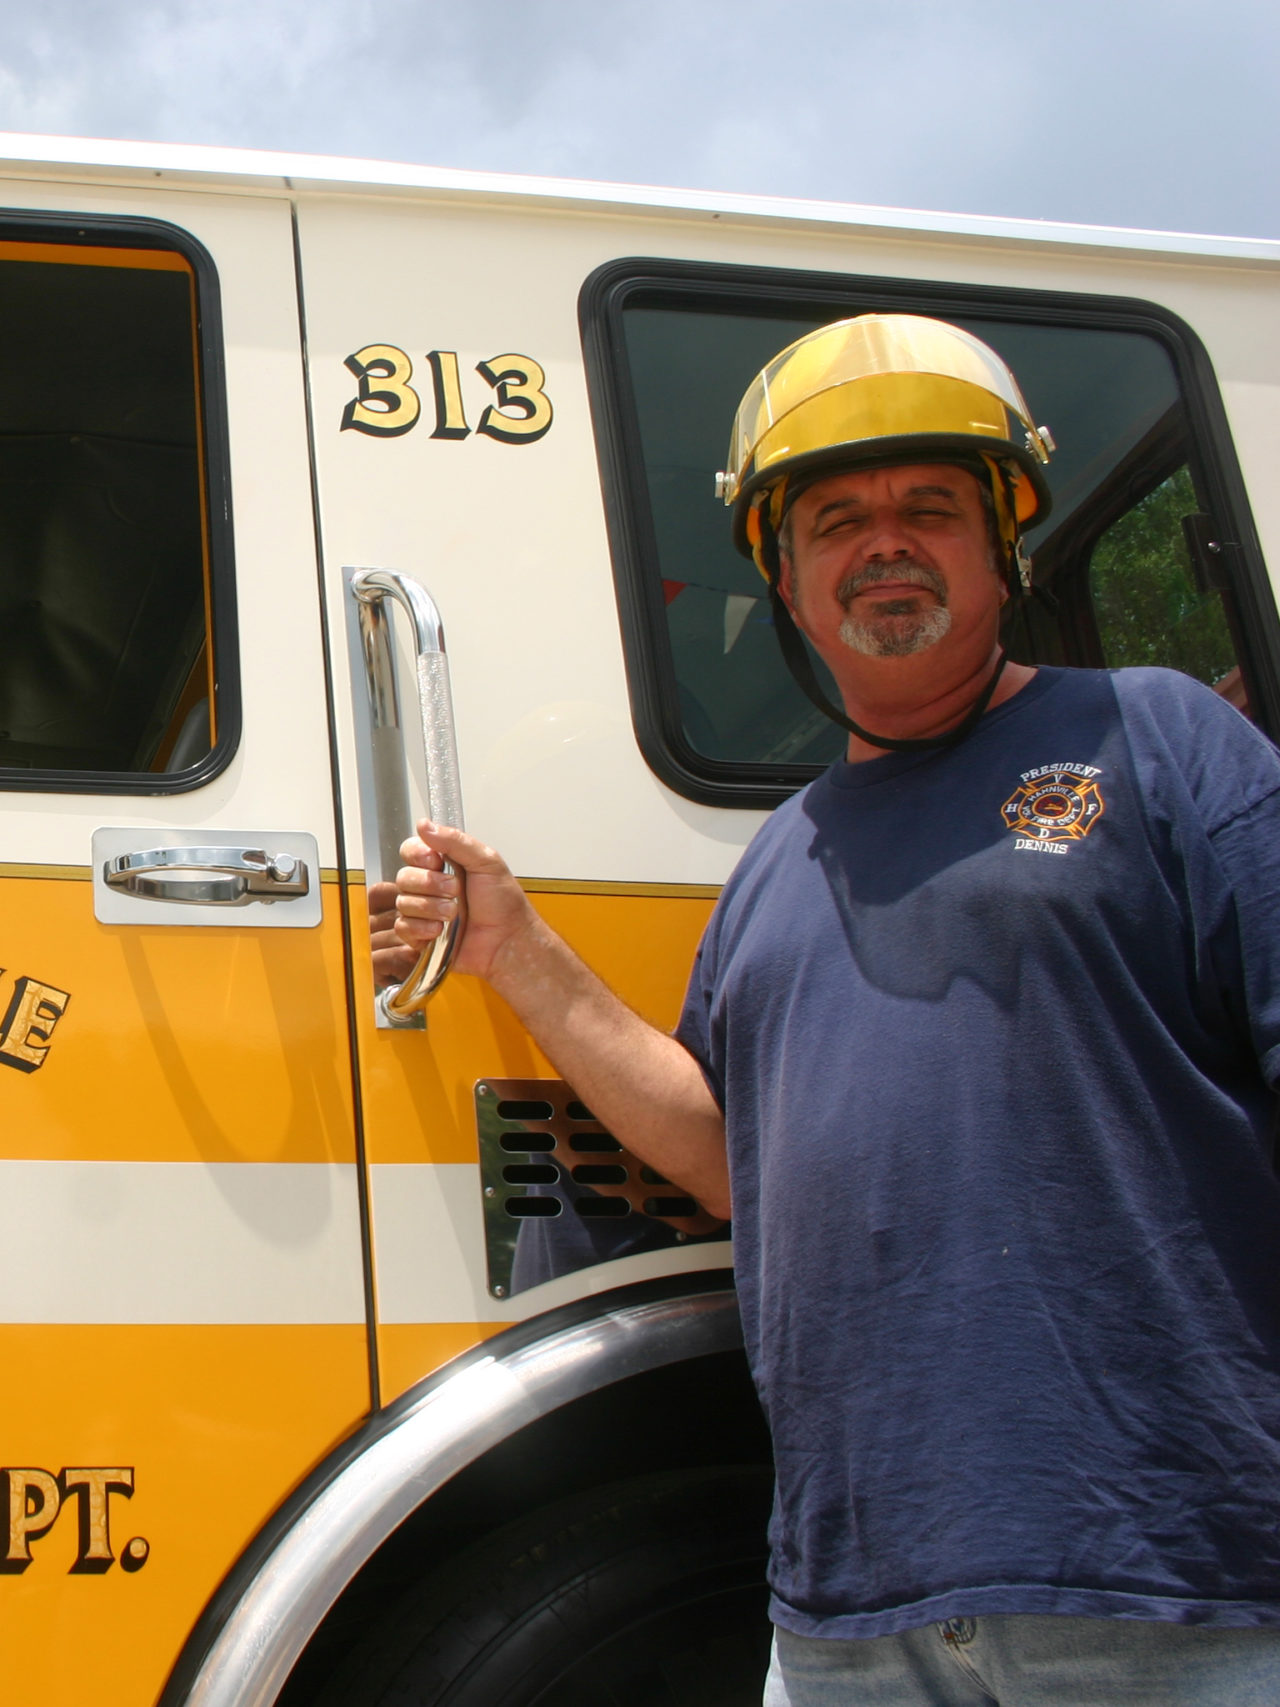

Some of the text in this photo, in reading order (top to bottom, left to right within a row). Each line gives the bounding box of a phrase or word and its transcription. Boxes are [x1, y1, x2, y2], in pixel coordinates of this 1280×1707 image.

[339, 343, 554, 446] 313
[1020, 762, 1102, 782] PRESIDENT
[1053, 774, 1066, 784] V
[1028, 785, 1080, 802] HAHNVILLE
[1005, 803, 1019, 813] H
[1085, 803, 1098, 815] F
[1031, 815, 1055, 826] FIRE
[1057, 807, 1081, 826] DEPT
[1039, 828, 1050, 838] D
[1014, 838, 1069, 854] DENNIS
